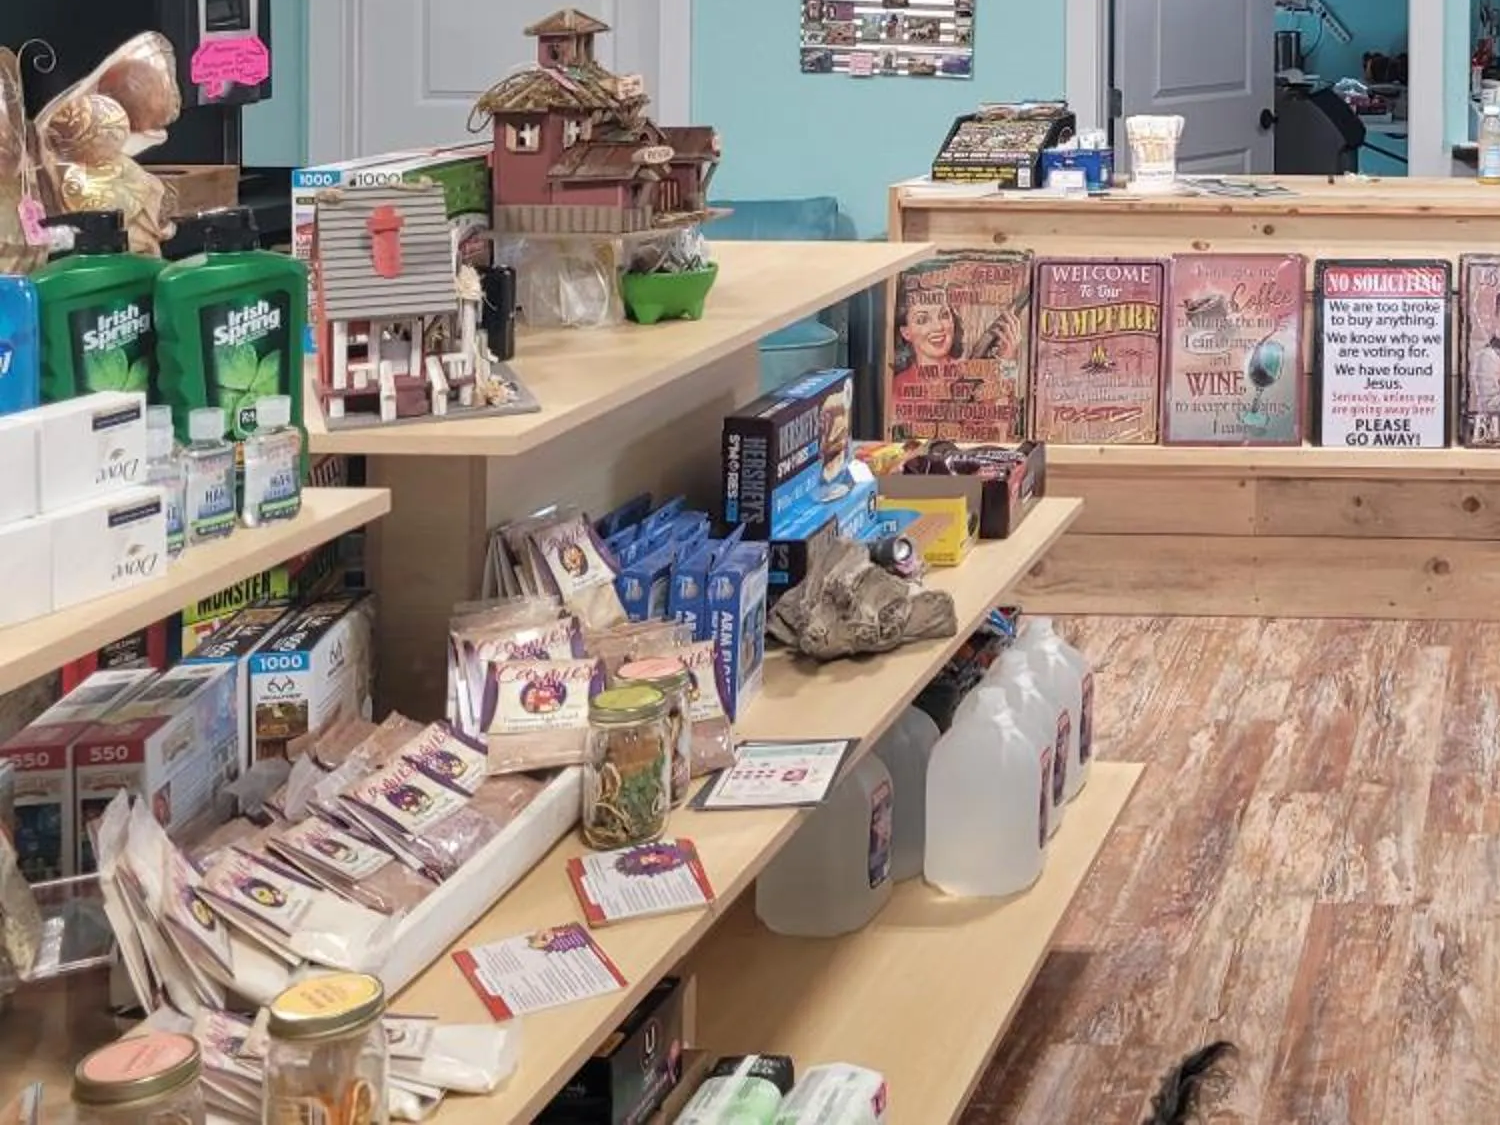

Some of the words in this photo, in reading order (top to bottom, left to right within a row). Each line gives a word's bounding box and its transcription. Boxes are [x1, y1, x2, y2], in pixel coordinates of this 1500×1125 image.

[300, 174, 333, 186] 1000
[1053, 266, 1150, 283] WELCOME
[1080, 284, 1093, 298] To
[1098, 285, 1122, 298] Our
[1328, 273, 1348, 292] NO
[1353, 273, 1441, 293] SOLICITING
[1229, 282, 1292, 313] Coffee
[228, 299, 270, 326] Irish
[1329, 302, 1349, 312] We
[1352, 304, 1373, 312] are
[1377, 302, 1398, 312] too
[1402, 301, 1440, 312] broke
[98, 303, 139, 331] Irish
[1041, 303, 1158, 338] CAMPFIRE
[1331, 315, 1344, 325] to
[1348, 314, 1373, 328] buy
[1375, 314, 1438, 329] anything.
[83, 313, 151, 351] Spring
[213, 308, 280, 346] Spring
[1327, 333, 1347, 343] We
[1351, 332, 1386, 343] know
[1390, 332, 1418, 343] who
[1422, 334, 1441, 343] we
[1339, 348, 1359, 357] are
[1363, 346, 1404, 360] voting
[1408, 345, 1429, 358] for.
[1335, 365, 1356, 375] We
[1359, 364, 1390, 375] have
[1393, 363, 1433, 376] found
[1364, 377, 1403, 390] Jesus.
[1332, 406, 1349, 414] are
[1351, 405, 1382, 417] giving
[1355, 419, 1411, 431] PLEASE
[1346, 433, 1369, 446] GO
[1373, 433, 1421, 446] AWAY!
[741, 437, 768, 524] HERSHEY'S
[260, 654, 303, 671] 1000
[90, 745, 129, 762] 550
